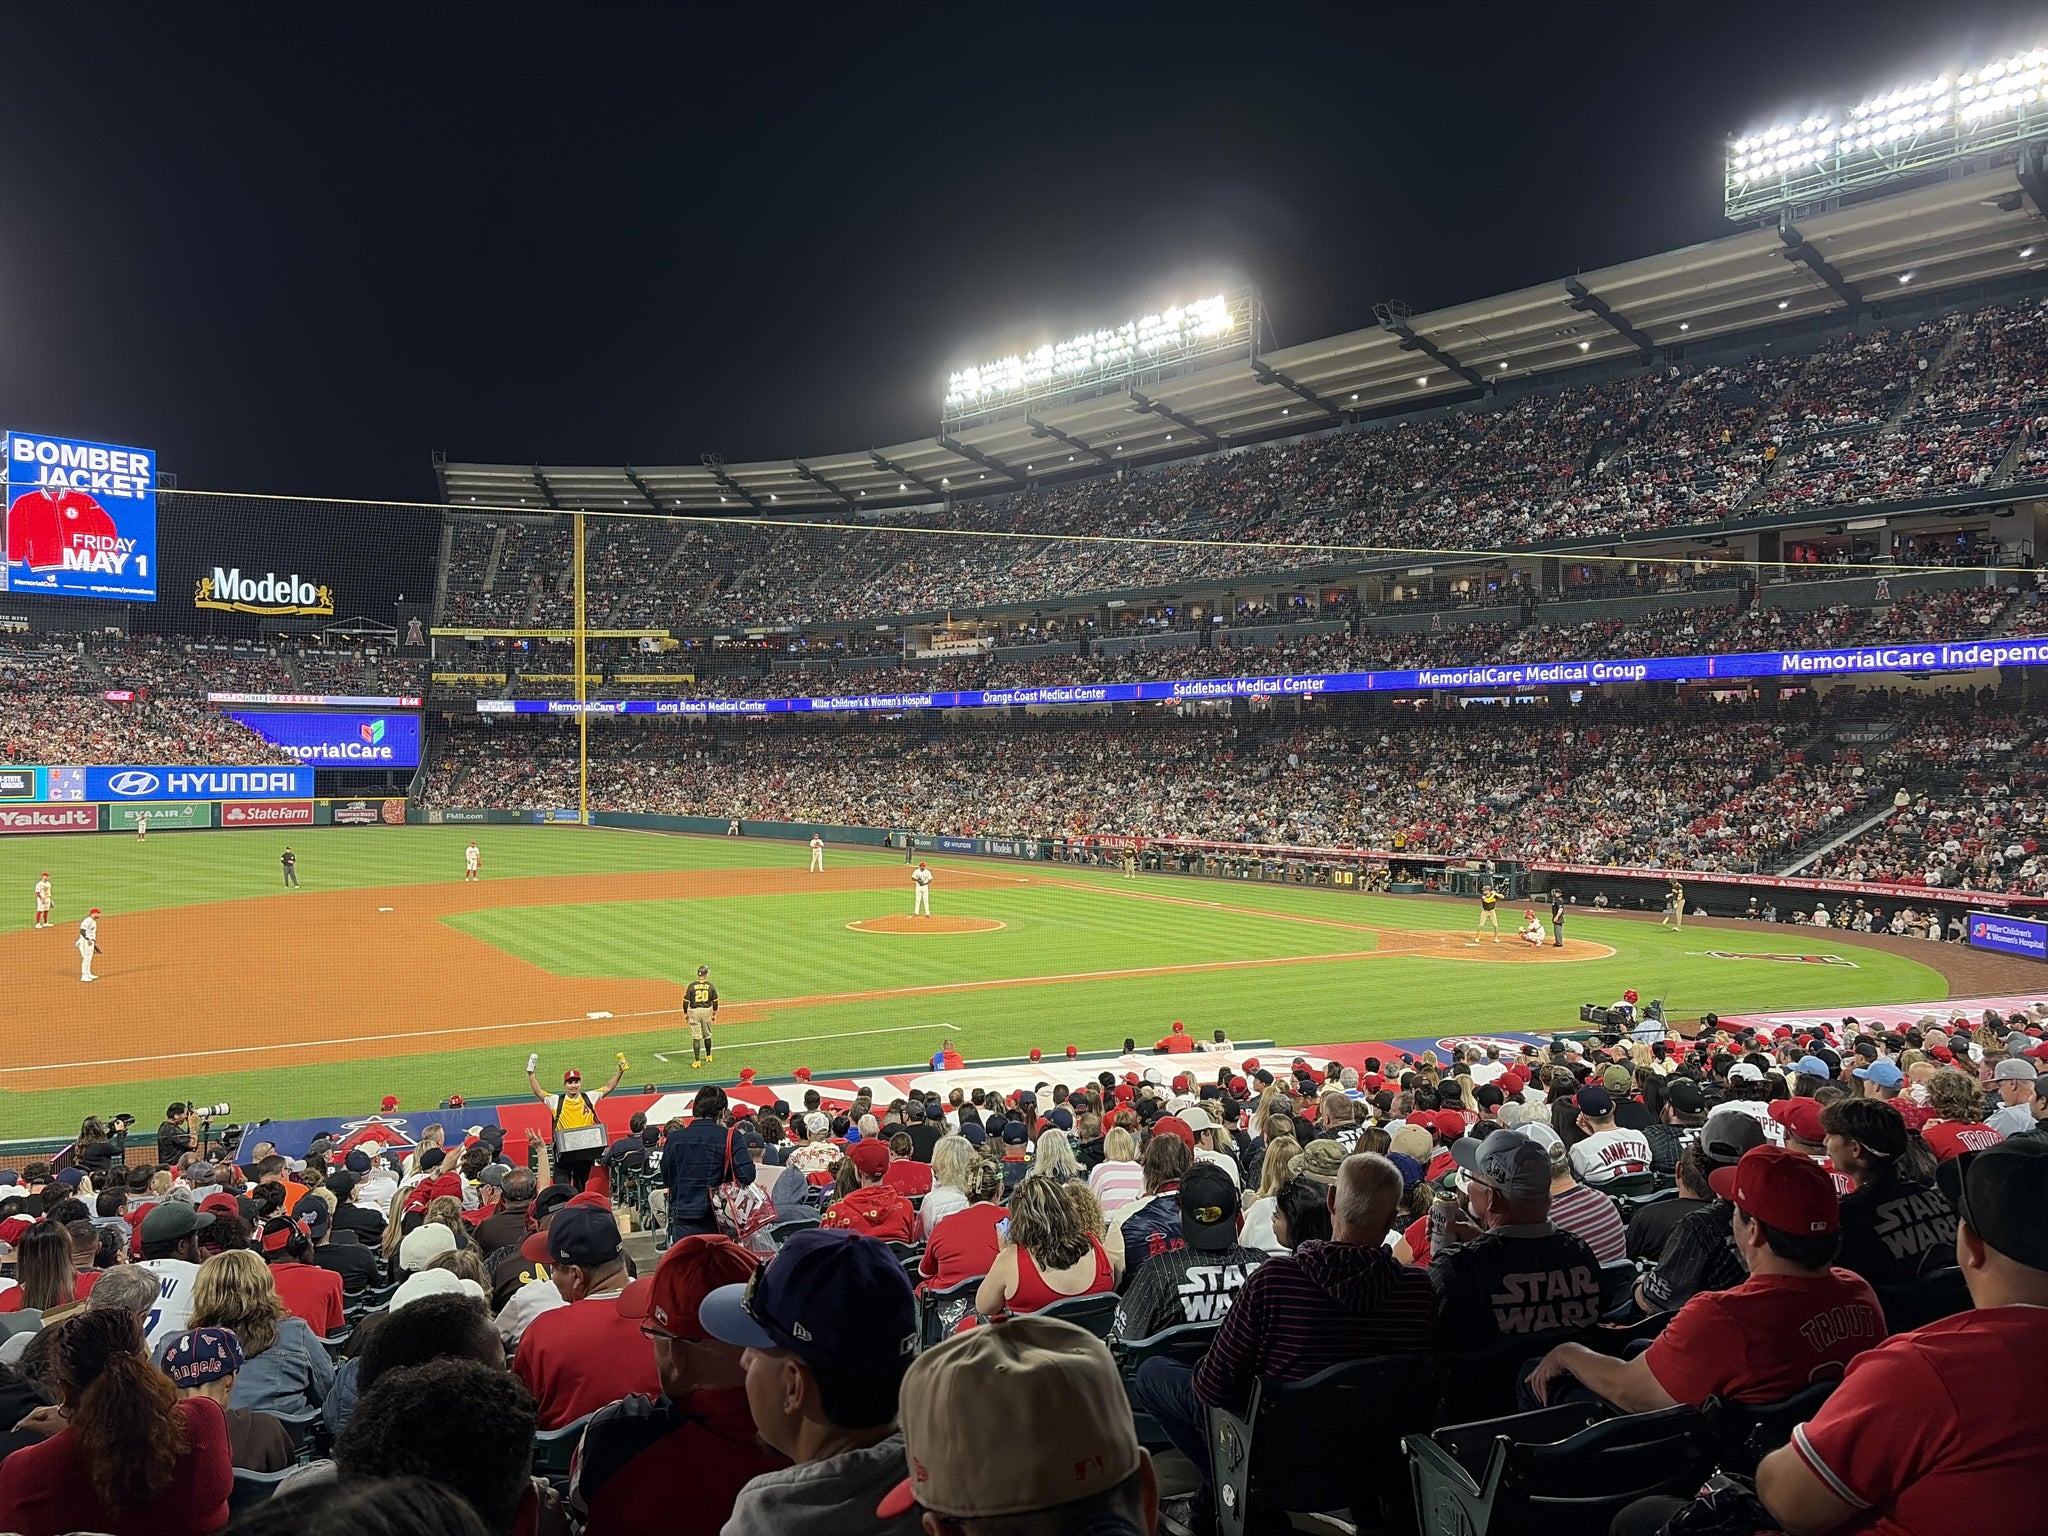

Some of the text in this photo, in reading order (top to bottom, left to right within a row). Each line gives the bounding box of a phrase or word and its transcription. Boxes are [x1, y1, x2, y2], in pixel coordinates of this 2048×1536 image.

[14, 438, 149, 477] BOMBER
[35, 465, 149, 499] JACKET
[73, 533, 136, 553] FRIDAY
[63, 547, 147, 577] MAY 1
[213, 567, 316, 605] Modelo
[1782, 650, 1935, 671] MemorialCare
[1419, 663, 1646, 684] MemorialCare Medical Group
[983, 688, 1105, 705] Orange Coast Medical Center
[1174, 678, 1325, 695] Saddleback Medical Center
[656, 701, 678, 712] Long
[680, 701, 706, 711] Beach
[708, 701, 739, 710] Medical
[740, 701, 766, 710] Center
[811, 699, 830, 708] Miller
[831, 698, 863, 707] Children's
[871, 697, 901, 706] Women's
[902, 695, 932, 706] Hospital
[72, 770, 80, 780] 4
[168, 773, 296, 793] HYUNDAI
[70, 789, 81, 799] 12
[0, 811, 92, 826] Yakult
[992, 842, 1012, 854] Modelo
[1986, 924, 2032, 938] Miller Children's
[1992, 933, 2018, 945] Women's
[694, 990, 709, 1002] 20
[1597, 1141, 1647, 1166] IANNETTA
[1873, 1189, 1951, 1235] STAR
[1490, 1265, 1600, 1305] STAR
[1492, 1295, 1600, 1335] WARS
[1799, 1305, 1875, 1353] TROUT
